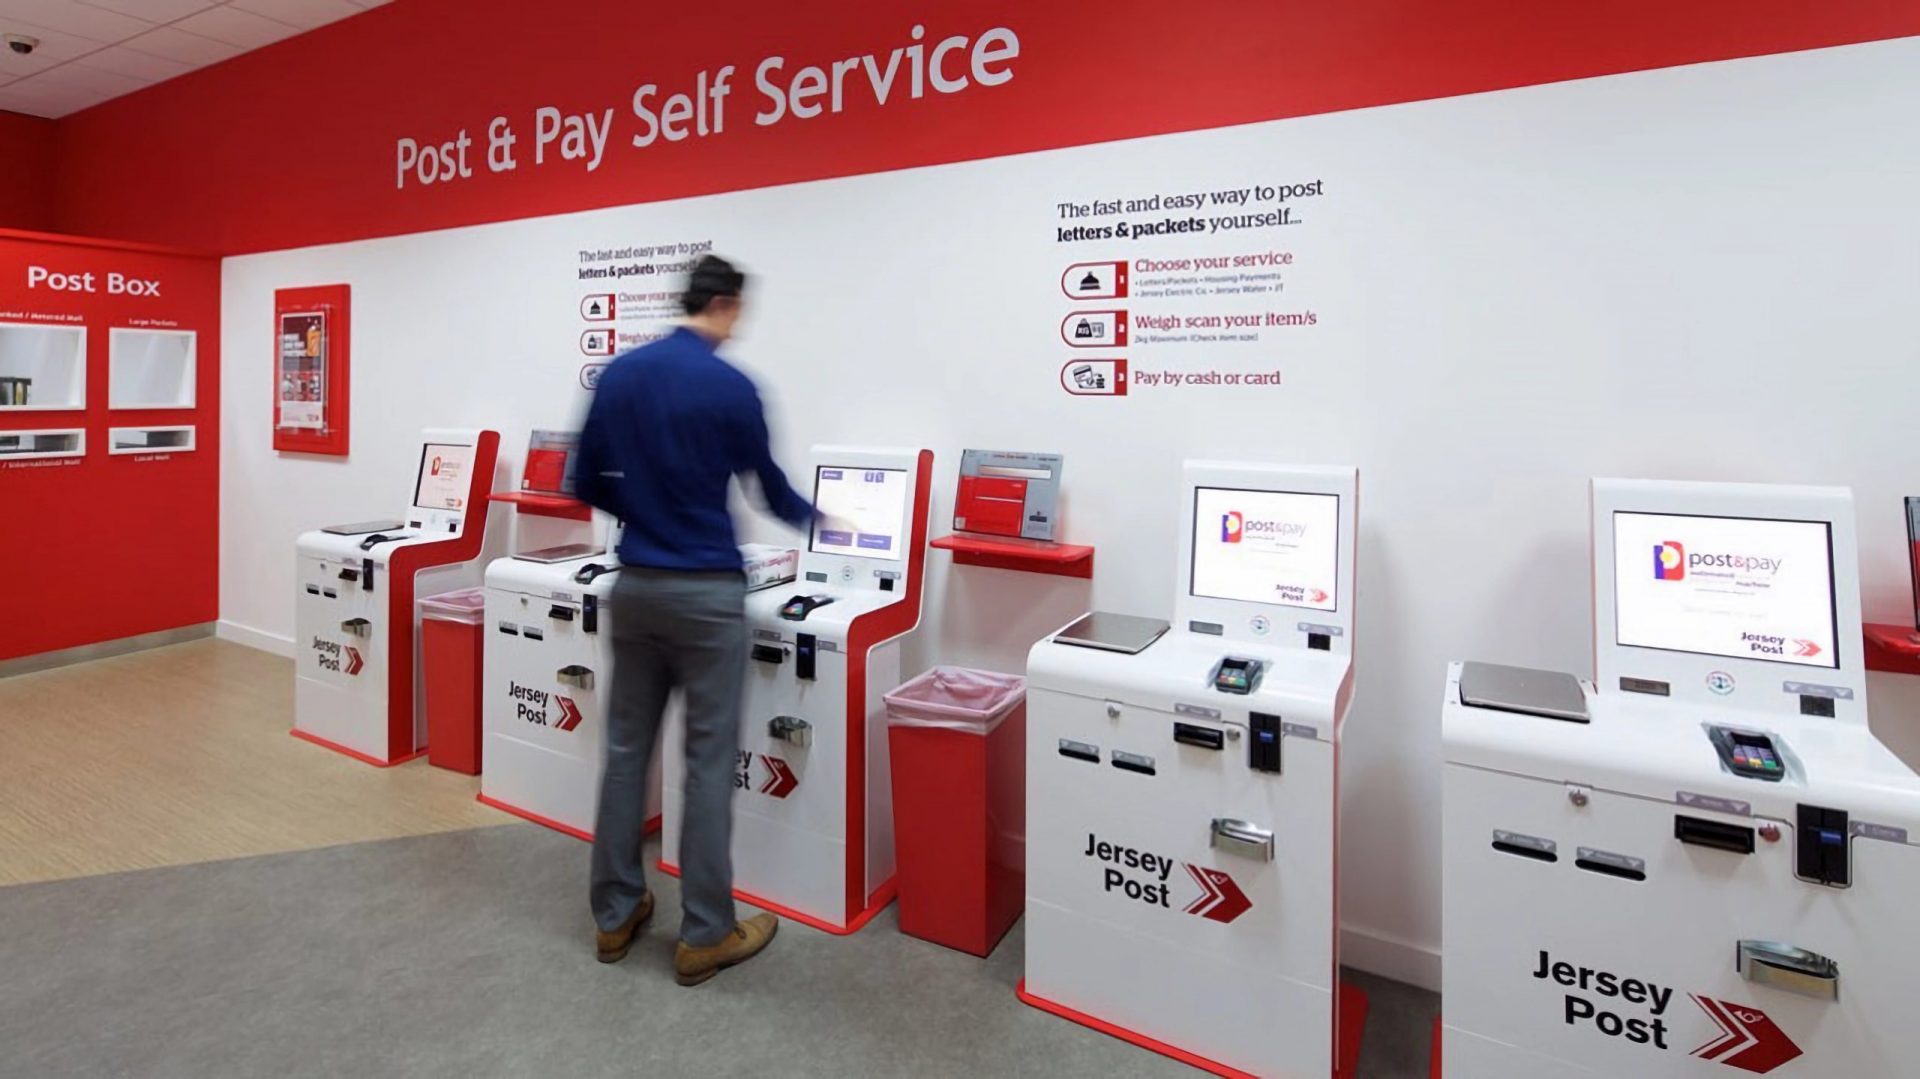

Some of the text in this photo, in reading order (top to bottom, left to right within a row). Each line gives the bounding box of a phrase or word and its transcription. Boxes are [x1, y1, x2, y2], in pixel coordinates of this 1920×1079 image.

[397, 24, 1020, 189] Post & Pay Self Service
[1058, 179, 1323, 219] The fast and easy way to post
[1058, 222, 1112, 242] letters
[1115, 222, 1129, 237] &
[1132, 217, 1206, 239] packets
[579, 250, 596, 262] The
[690, 240, 713, 255] post
[1135, 251, 1293, 273] Choose your service
[28, 266, 161, 297] Post Box
[579, 268, 607, 279] letters
[617, 263, 655, 279] packets
[1136, 310, 1317, 331] Weigh scan your item/s
[1134, 370, 1281, 387] Pay by cash or card
[1689, 553, 1782, 575] post&pay
[313, 635, 341, 658] Jersey
[1741, 632, 1785, 646] Jersey
[1751, 643, 1783, 655] Post
[319, 654, 340, 672] Post
[509, 680, 549, 708] Jersey
[517, 703, 548, 726] Post
[1085, 833, 1174, 881] Jersey
[1104, 868, 1171, 909] Post
[1532, 950, 1673, 1016] Jersey
[1564, 994, 1669, 1050] Post
